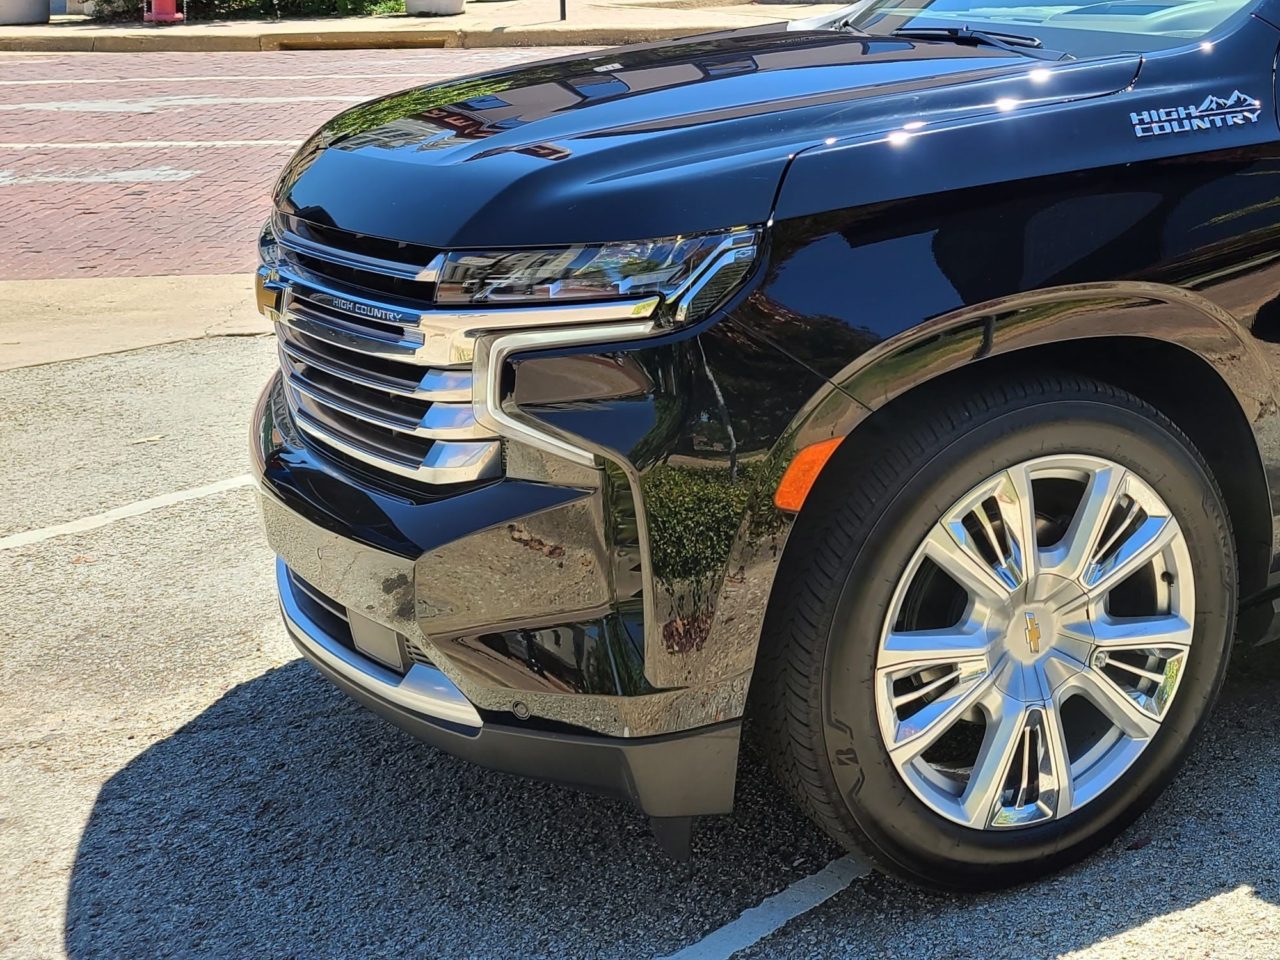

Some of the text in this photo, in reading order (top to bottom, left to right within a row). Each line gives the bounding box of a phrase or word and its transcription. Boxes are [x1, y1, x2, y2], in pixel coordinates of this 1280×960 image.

[1130, 105, 1198, 125] HIGH
[1134, 110, 1261, 137] COUNTRY
[332, 297, 402, 321] HIGH COUNTRY
